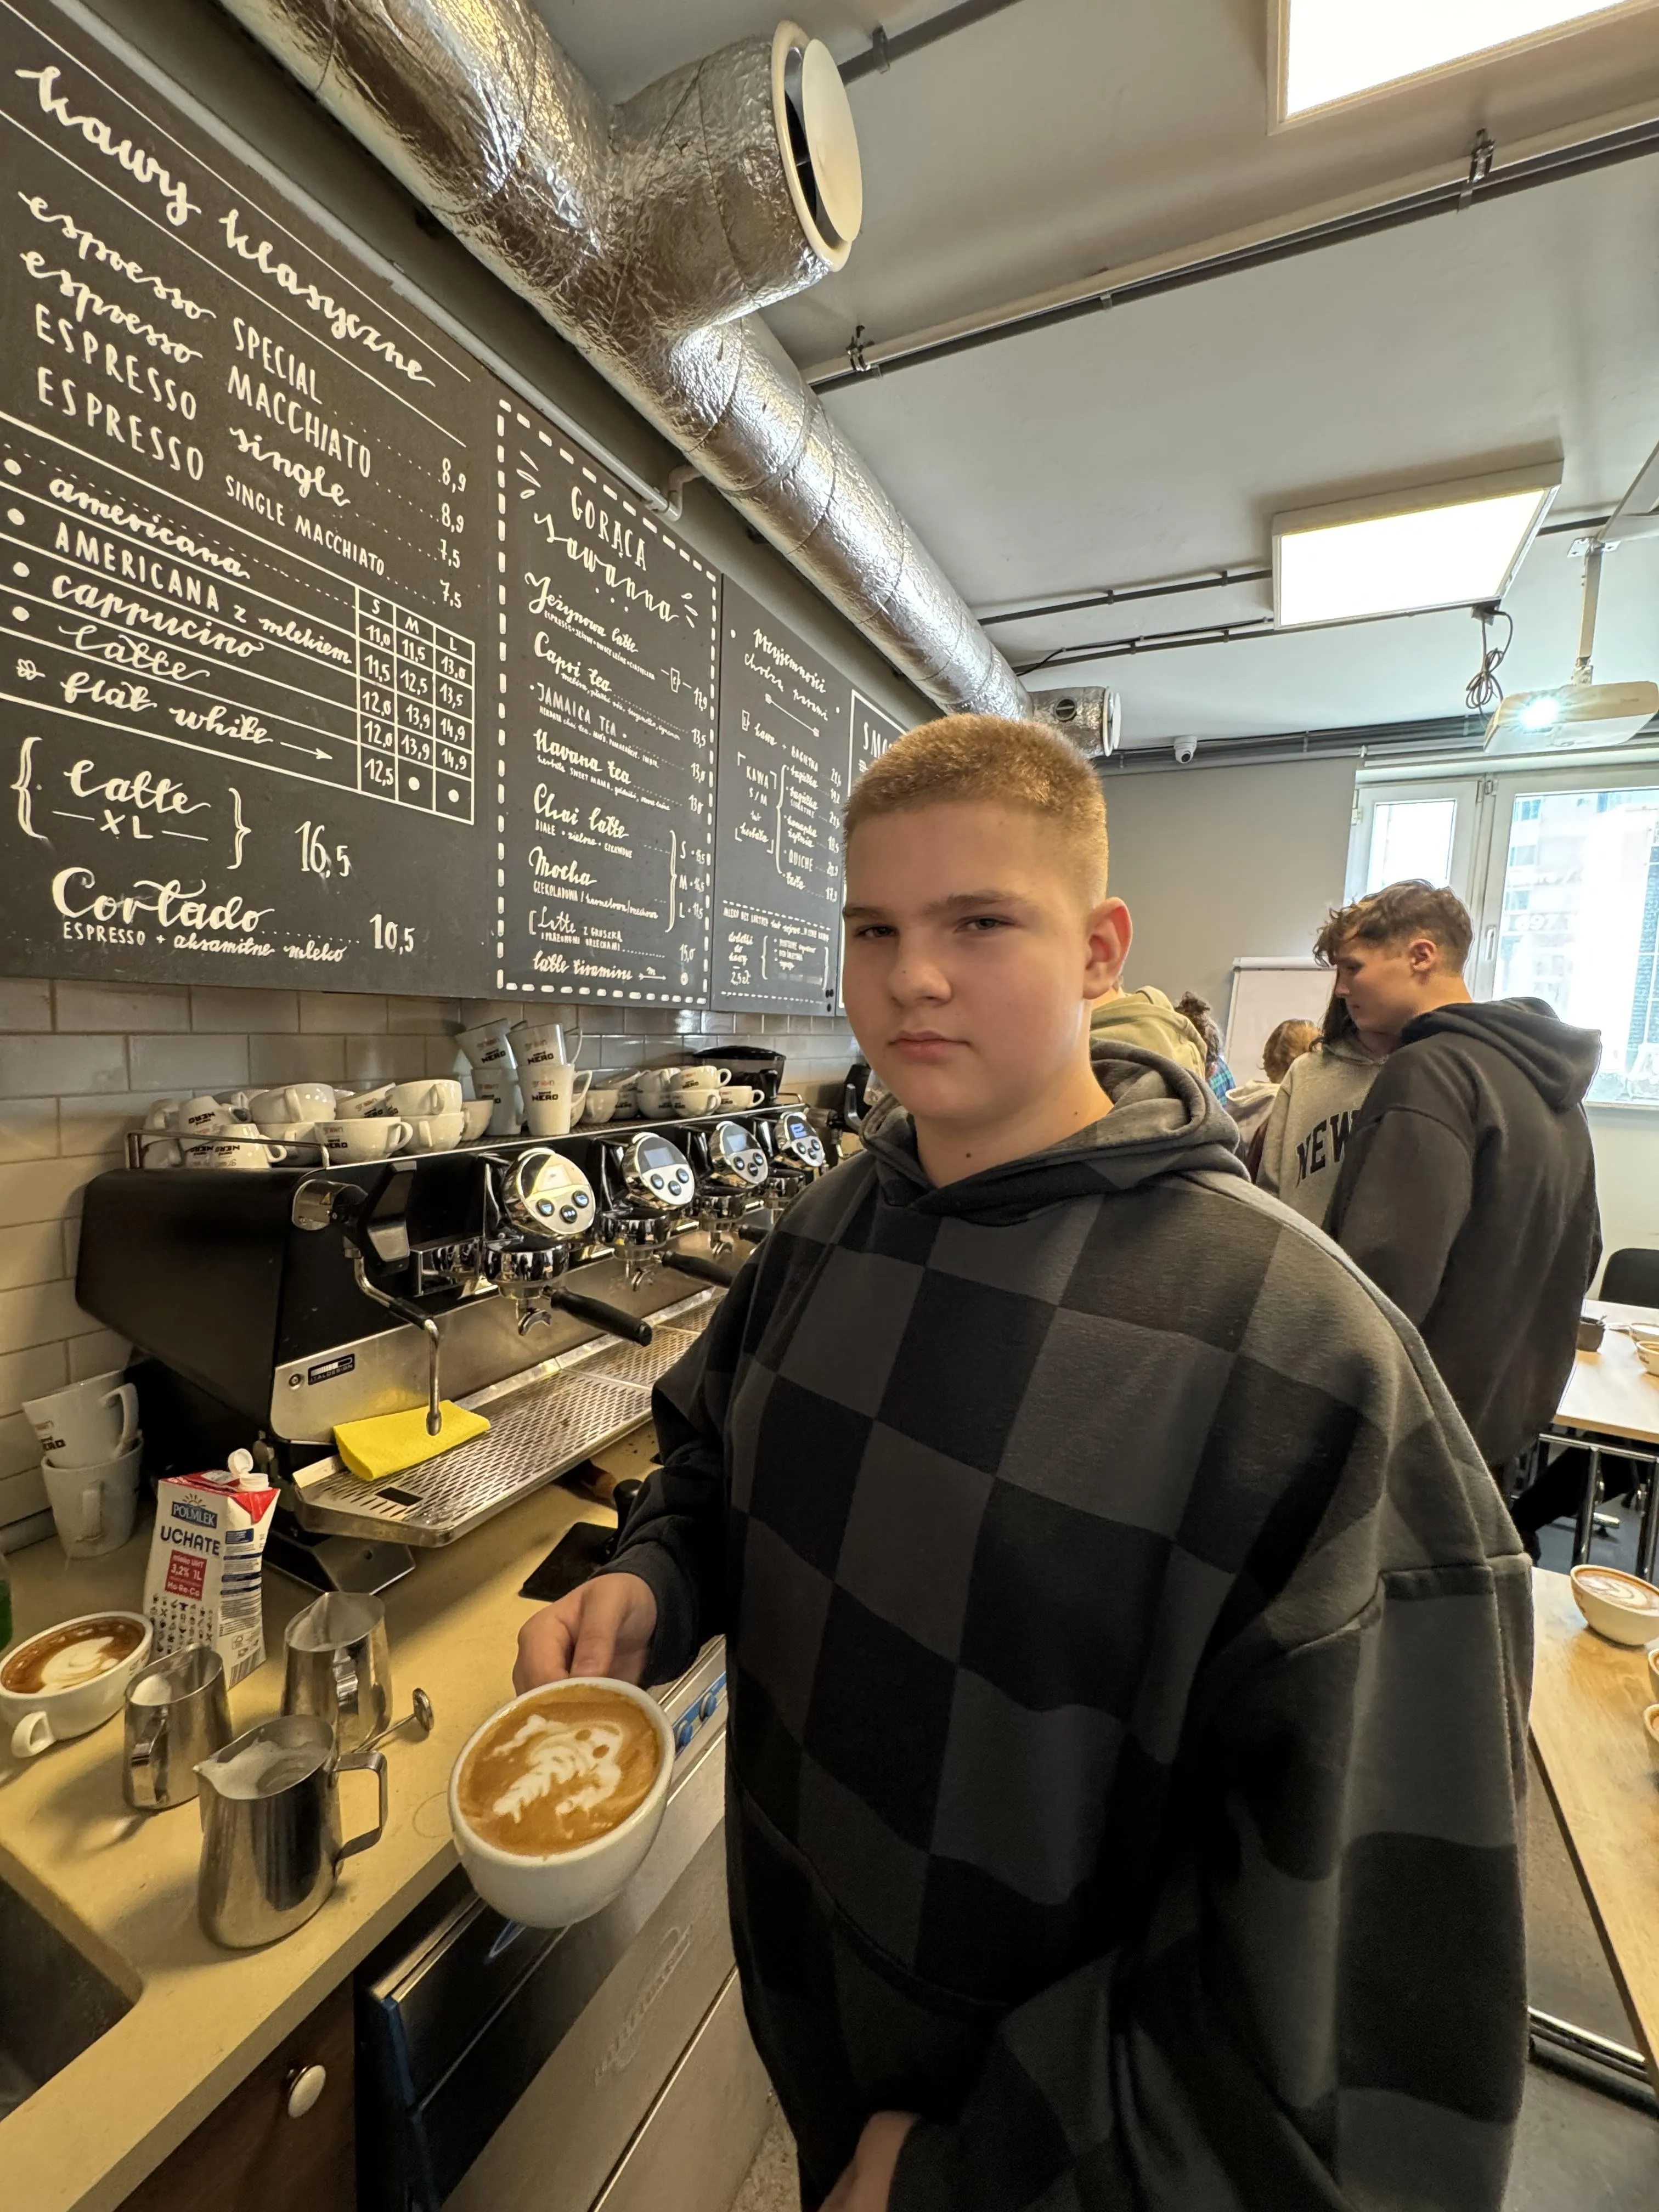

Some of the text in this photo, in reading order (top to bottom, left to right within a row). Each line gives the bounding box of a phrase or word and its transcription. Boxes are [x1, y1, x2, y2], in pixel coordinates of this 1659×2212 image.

[15, 66, 435, 387] kawy klasyczne
[19, 192, 466, 493] espresso SPECIAL 8,9
[20, 252, 464, 533] espresso MACCHIATO 8,9
[36, 303, 460, 568] ESPRESSO single 7,5
[38, 367, 461, 608] ESPRESSO SINGLE MACCHIATO 7,5
[571, 487, 646, 571] GORĄCA
[49, 479, 466, 680] americana 11,0 11,5 13,0
[55, 522, 219, 612] AMERICANA
[258, 619, 352, 664] mlekiem
[364, 654, 390, 682] 11,5
[400, 670, 428, 695] 12,5
[439, 684, 464, 708] 13,5
[372, 599, 457, 651] S M L
[612, 628, 638, 653] latte
[534, 631, 581, 678] Capri
[588, 668, 612, 692] tea
[60, 673, 394, 786] flat white 12,5
[362, 692, 391, 715] 12,0
[405, 704, 430, 730] 13,9
[440, 718, 465, 742] 14,9
[537, 682, 591, 725] JAMAICA
[599, 715, 617, 737] TEA
[364, 721, 393, 747] 12,0
[401, 735, 430, 760] 13,9
[442, 748, 466, 770] 14,9
[533, 728, 632, 785] Havana tea
[692, 728, 707, 748] 13,5
[570, 768, 589, 781] SWEET
[746, 765, 769, 789] KAWA
[533, 783, 629, 839] Chai latte
[535, 819, 555, 836] BIAŁE
[296, 821, 351, 878] 16,5
[528, 846, 597, 886] Mocha
[788, 849, 814, 872] QUICHE
[53, 867, 415, 955] Cortado 10,5
[64, 922, 145, 946] ESPRESSO
[174, 933, 275, 957] aksamitne
[283, 945, 346, 962] mleko
[533, 950, 569, 974] latte
[481, 1051, 506, 1063] NERO
[527, 1053, 554, 1064] NERO
[161, 1525, 221, 1556] UCHATE
[173, 1504, 216, 1527] POLMLEK
